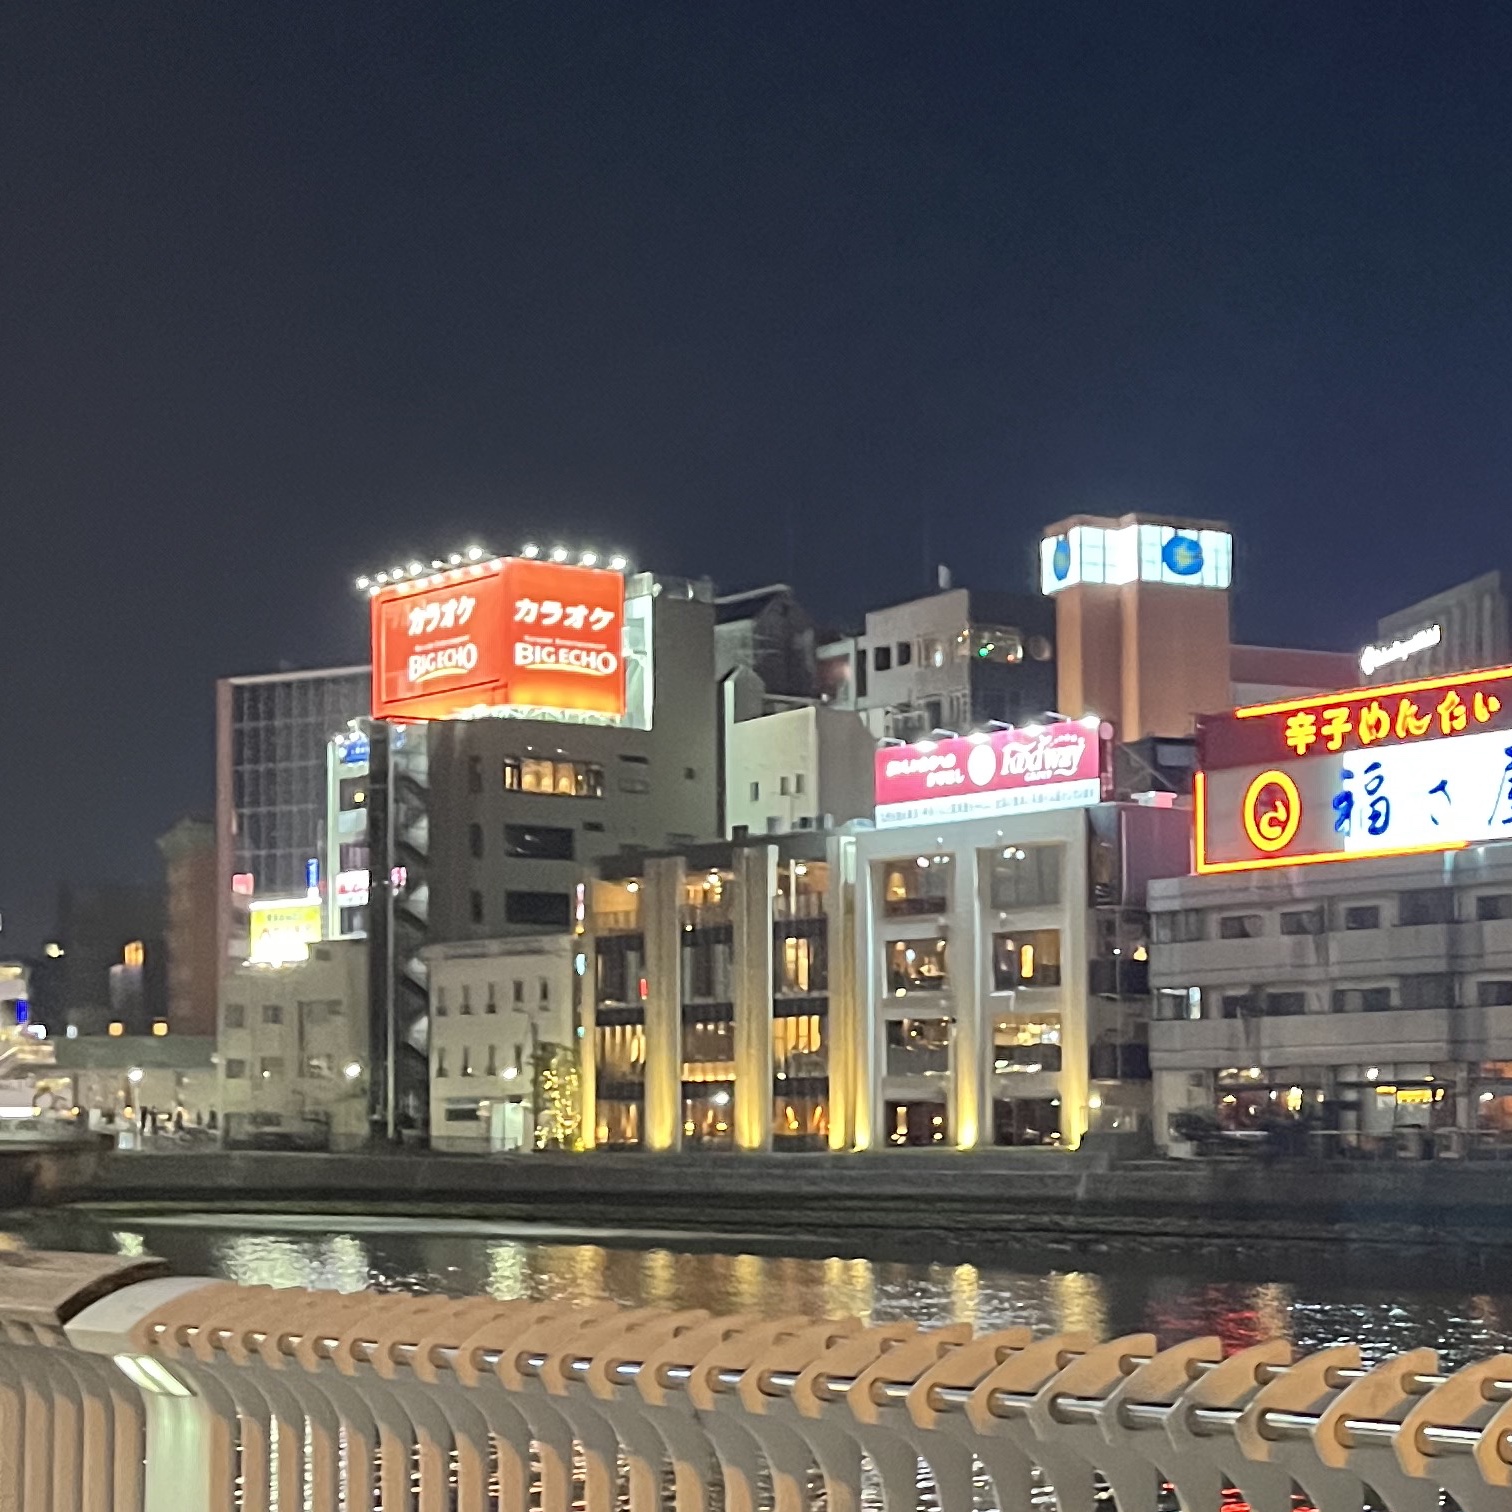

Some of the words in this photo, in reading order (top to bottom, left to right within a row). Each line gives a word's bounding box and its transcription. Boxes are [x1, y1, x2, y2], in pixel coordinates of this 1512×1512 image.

[408, 596, 476, 636] カラオケ
[514, 598, 615, 631] カラオケ
[1285, 690, 1501, 756] 辛子めんたい
